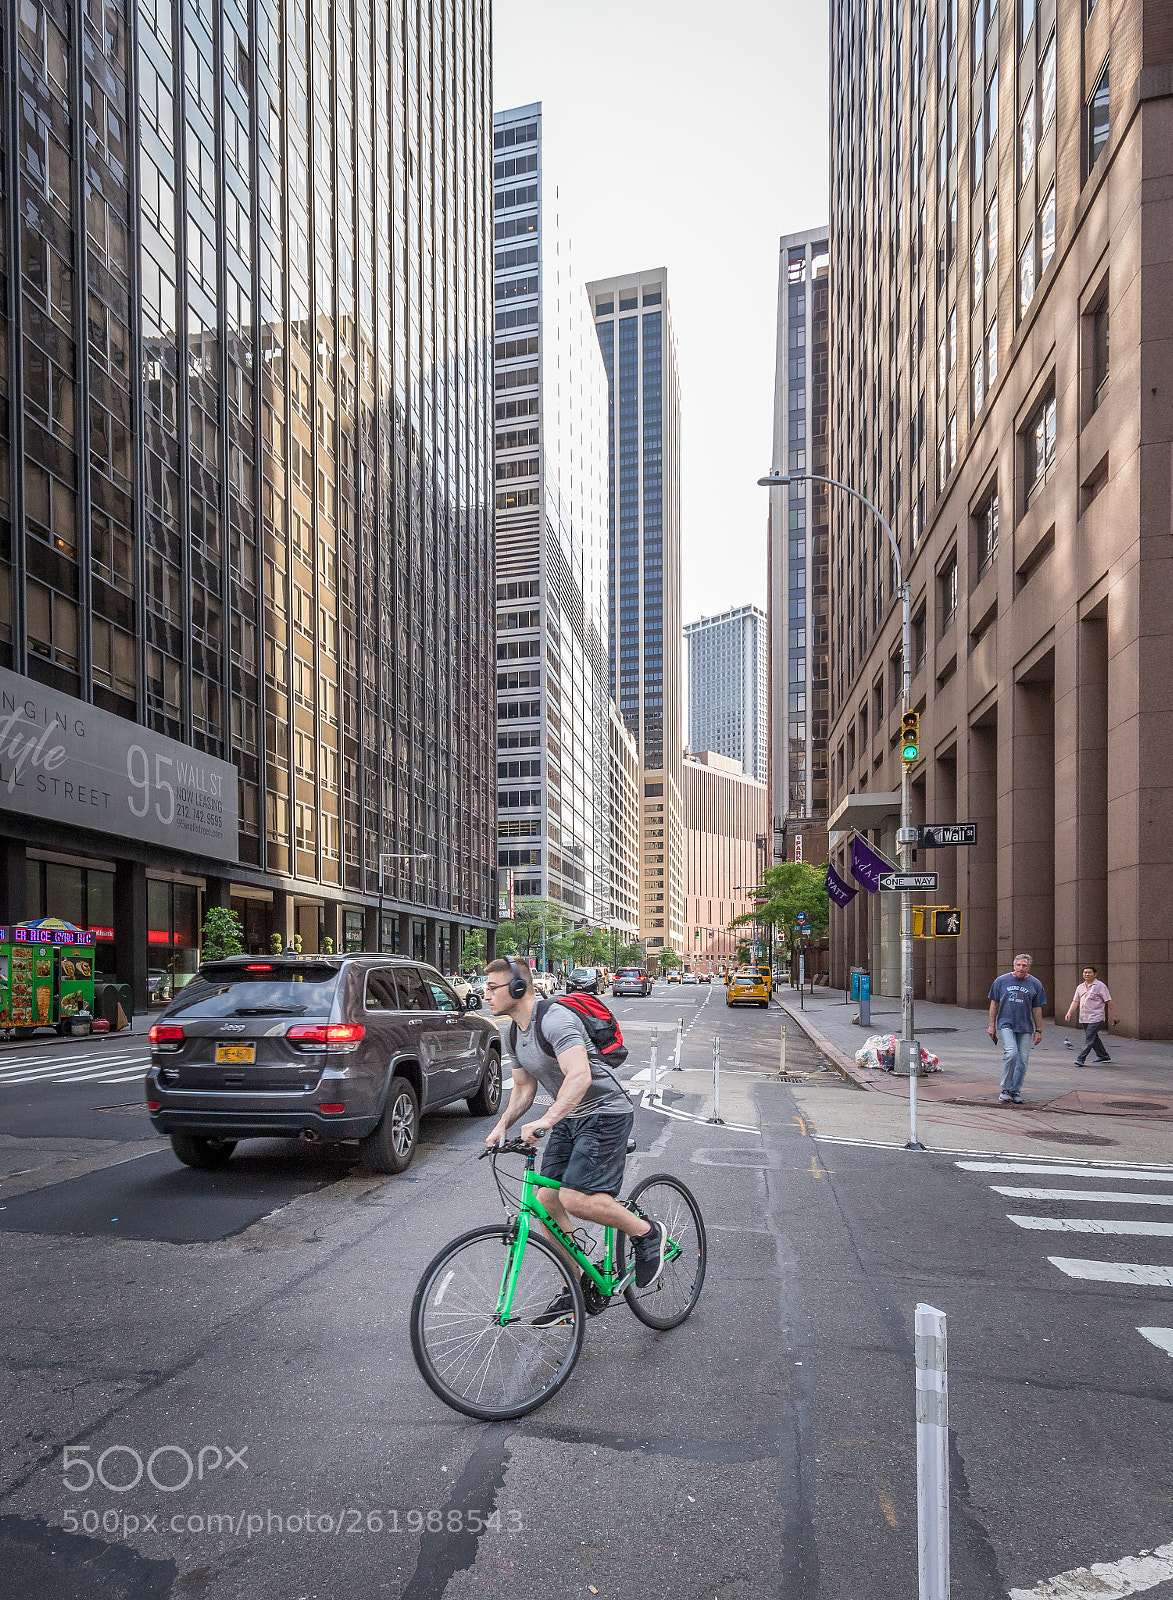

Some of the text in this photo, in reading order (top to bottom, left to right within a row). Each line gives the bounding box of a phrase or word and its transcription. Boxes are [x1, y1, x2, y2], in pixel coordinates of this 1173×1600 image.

[37, 774, 111, 809] STREET
[127, 744, 175, 824] 95
[176, 759, 223, 798] WALL ST
[176, 786, 223, 814] NOW LEASING
[944, 829, 965, 842] Wall
[885, 877, 933, 886] ONE WAY
[30, 930, 52, 941] RICE
[54, 931, 74, 943] GYRO
[220, 1023, 246, 1033] Jeep
[545, 1211, 579, 1255] TREK
